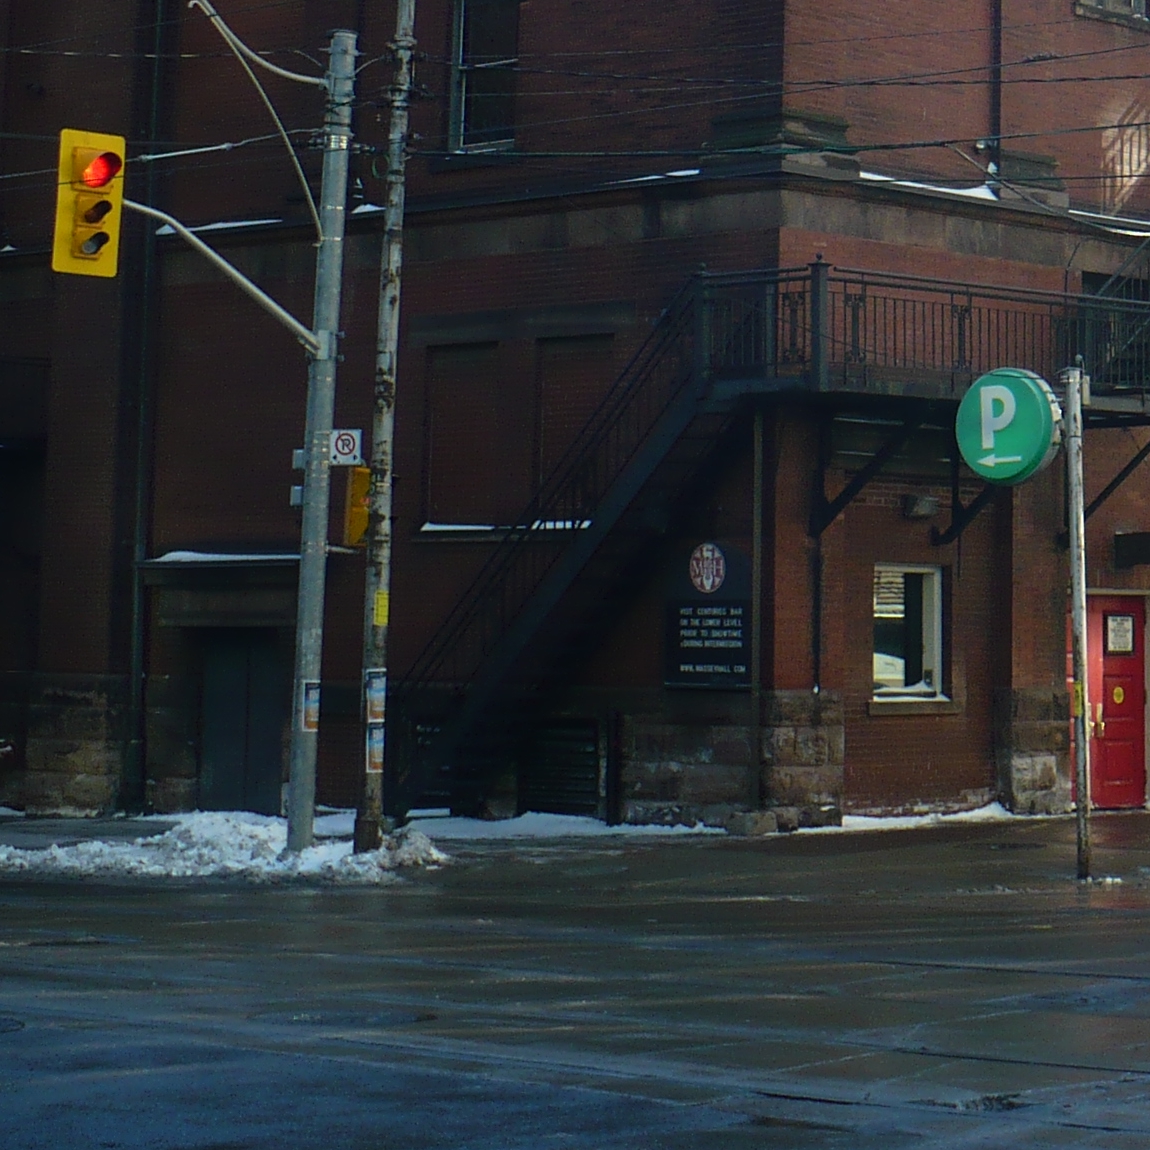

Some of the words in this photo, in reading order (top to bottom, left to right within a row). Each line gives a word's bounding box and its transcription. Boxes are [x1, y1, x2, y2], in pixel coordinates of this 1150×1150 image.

[980, 384, 1017, 450] P
[723, 618, 743, 626] LEVEL
[700, 629, 709, 638] TO
